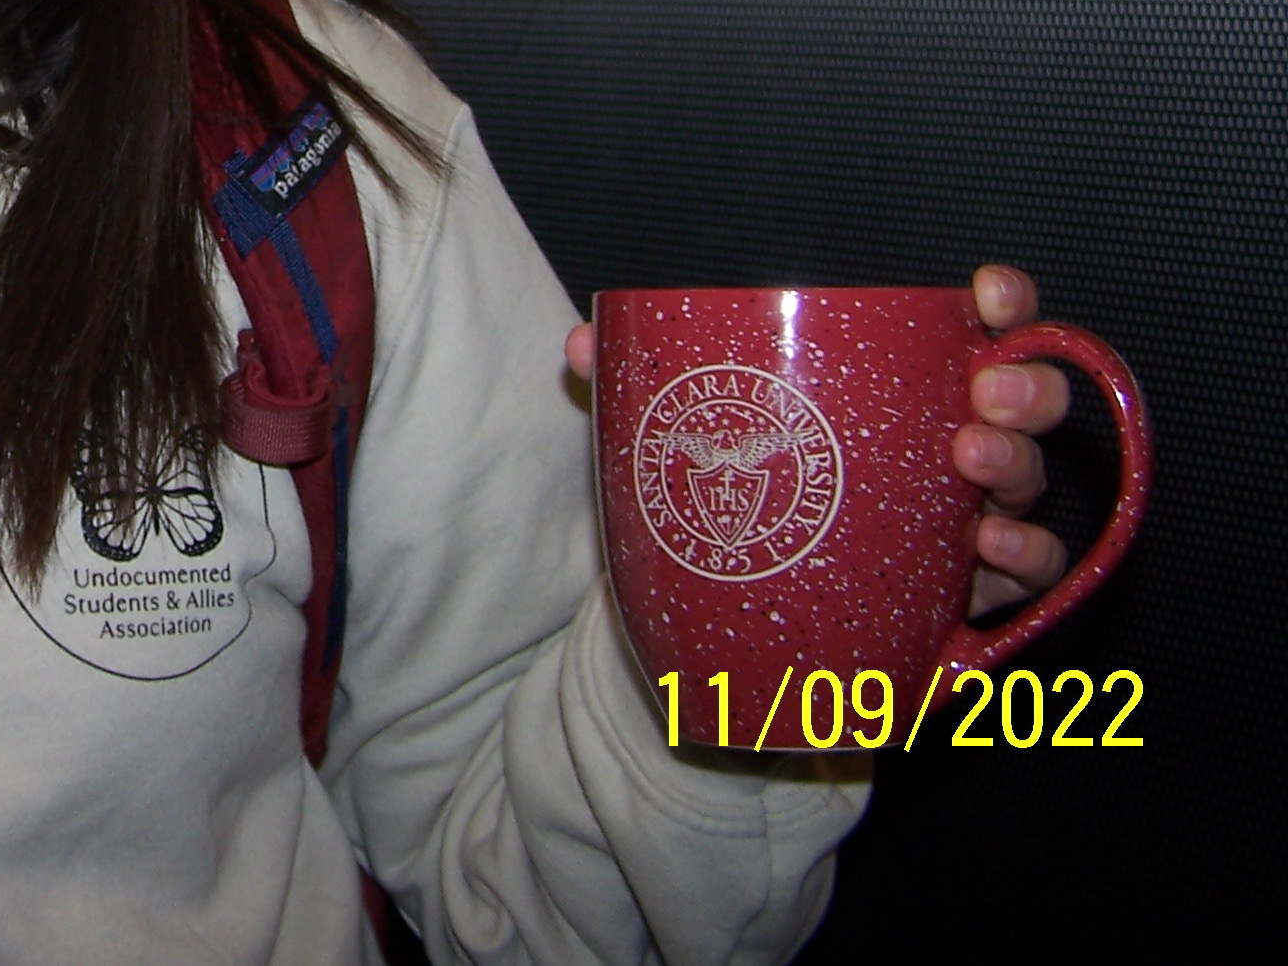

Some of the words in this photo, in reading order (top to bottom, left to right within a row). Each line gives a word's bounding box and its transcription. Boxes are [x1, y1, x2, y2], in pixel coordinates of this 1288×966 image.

[273, 120, 343, 200] patagonia
[654, 374, 742, 425] CLARA
[640, 430, 674, 528] SANTA
[750, 378, 833, 536] UNIVERSITY
[73, 563, 232, 589] Undocumented
[64, 593, 160, 616] Students
[166, 592, 180, 610] &
[186, 588, 235, 609] Allies
[99, 616, 213, 639] Association
